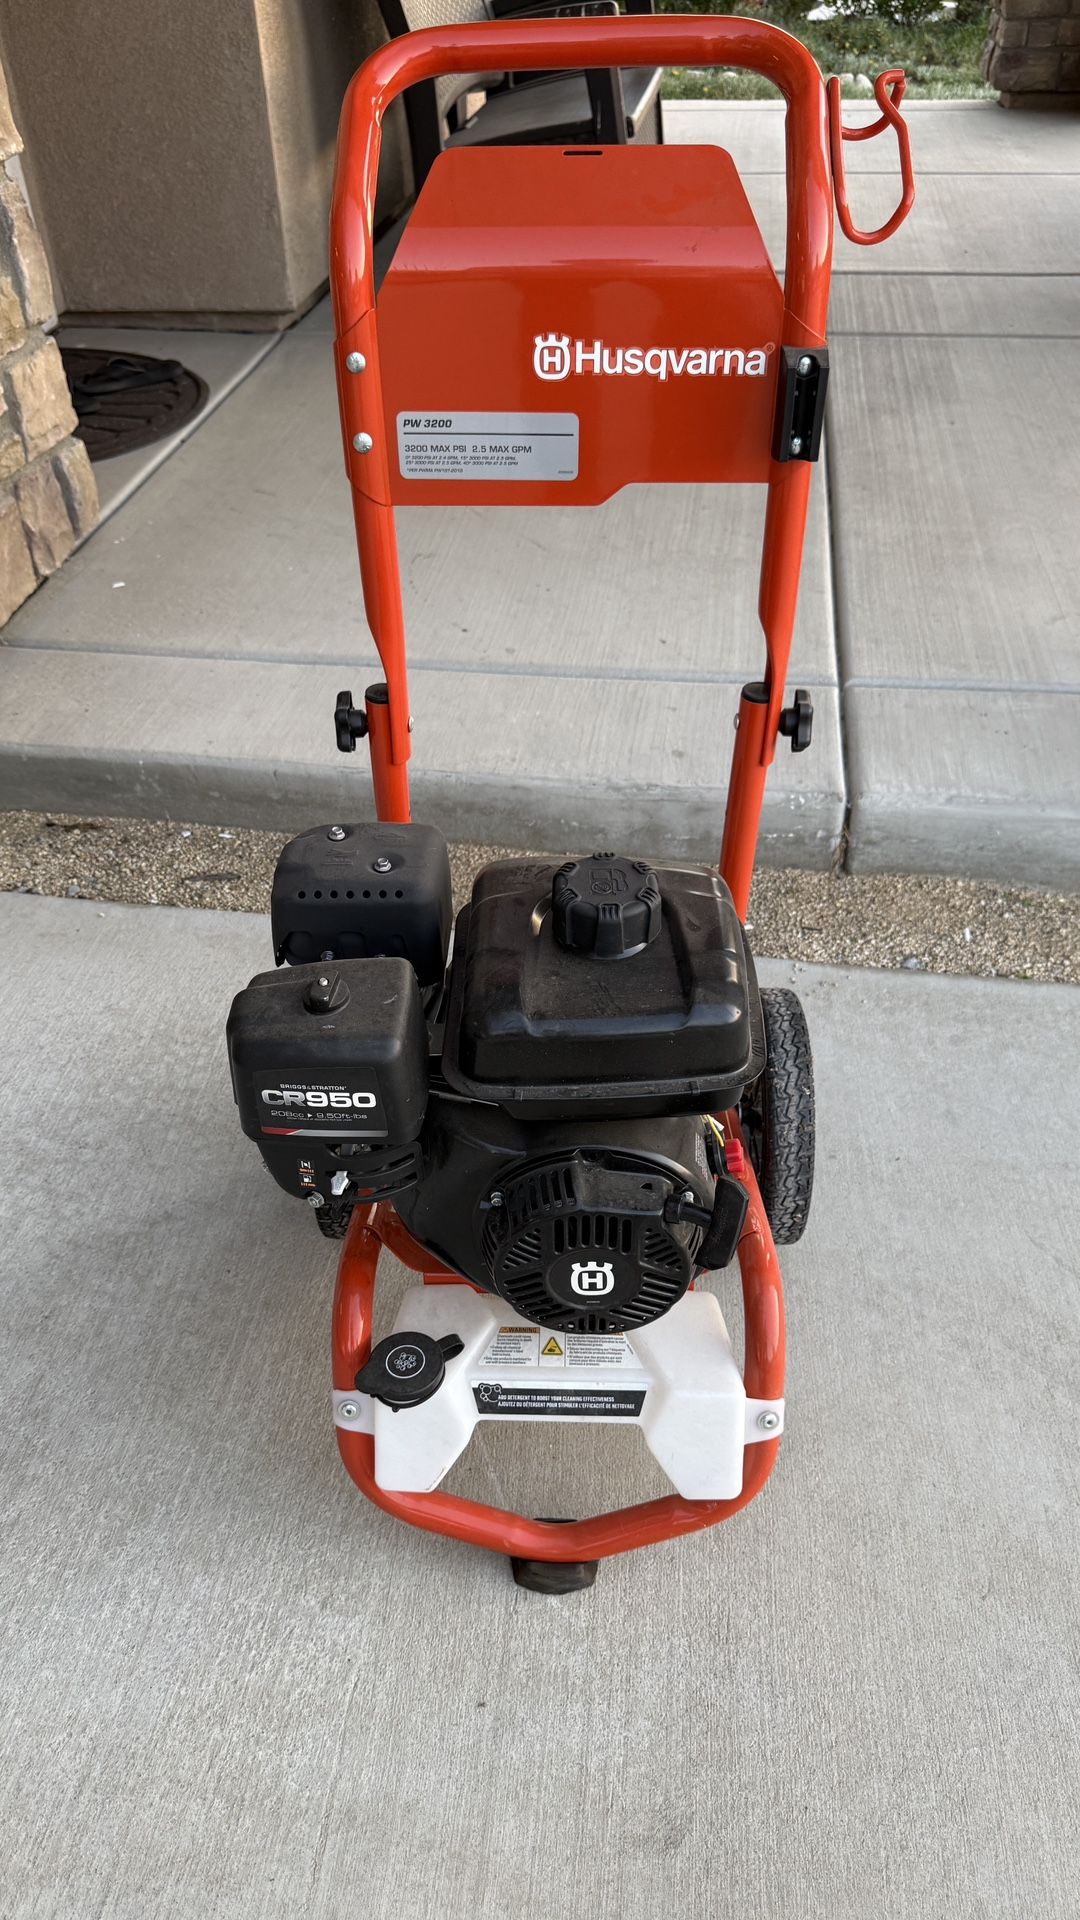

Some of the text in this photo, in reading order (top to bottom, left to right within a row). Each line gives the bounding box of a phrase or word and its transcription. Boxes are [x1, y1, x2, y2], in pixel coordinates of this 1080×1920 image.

[575, 341, 766, 380] Husqvarna
[403, 419, 452, 428] PW 3200
[405, 445, 428, 453] 3200
[430, 445, 450, 453] MAX
[453, 445, 467, 453] PSI
[472, 445, 487, 453] 2.5
[489, 445, 509, 453] MAX
[261, 1089, 377, 1108] CR950
[270, 1110, 305, 1118] 208cc
